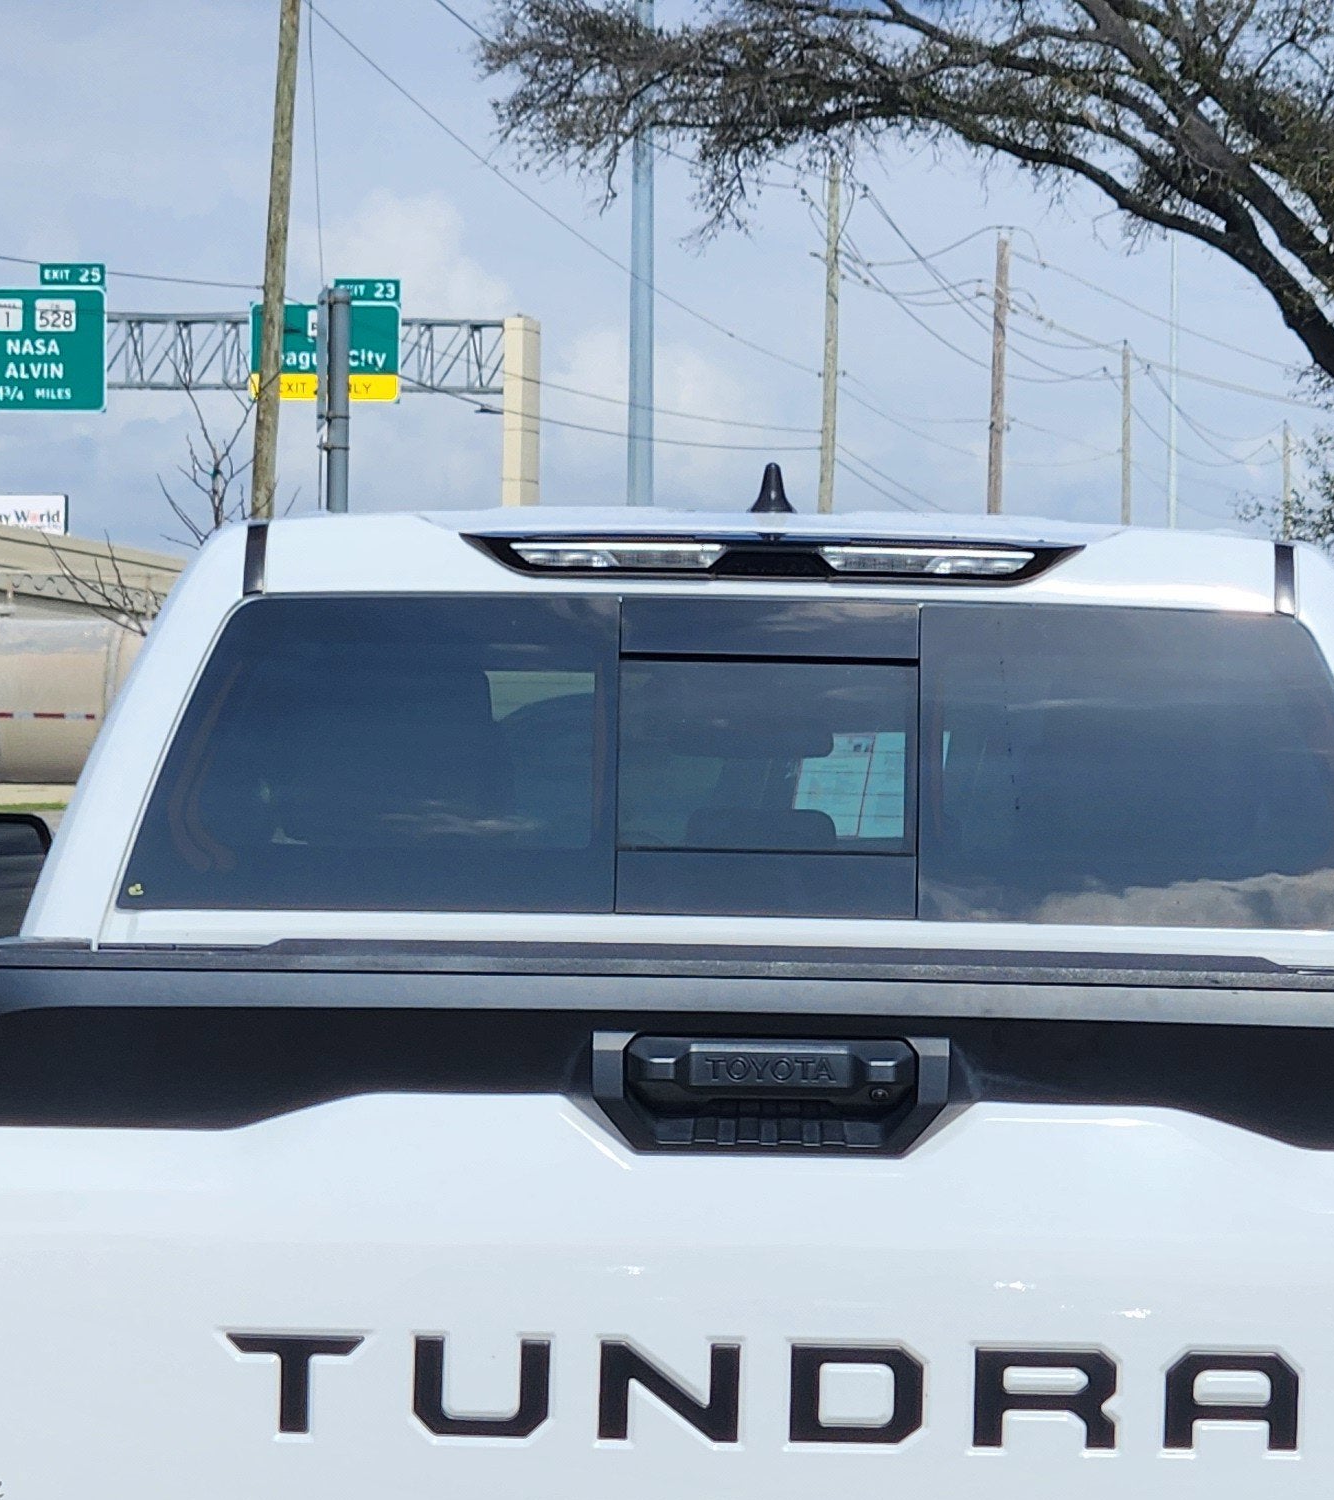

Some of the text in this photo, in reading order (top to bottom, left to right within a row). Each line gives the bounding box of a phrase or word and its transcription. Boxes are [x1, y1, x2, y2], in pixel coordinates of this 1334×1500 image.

[43, 267, 101, 283] EXIT 25
[374, 282, 395, 298] 23
[5, 311, 10, 328] 1
[39, 310, 73, 328] 528
[6, 338, 60, 356] NASA
[348, 349, 387, 372] City
[4, 362, 64, 379] ALVIN
[35, 388, 72, 400] MILES
[705, 1056, 837, 1084] TOYOTA
[225, 1331, 1300, 1451] TUNDRA
